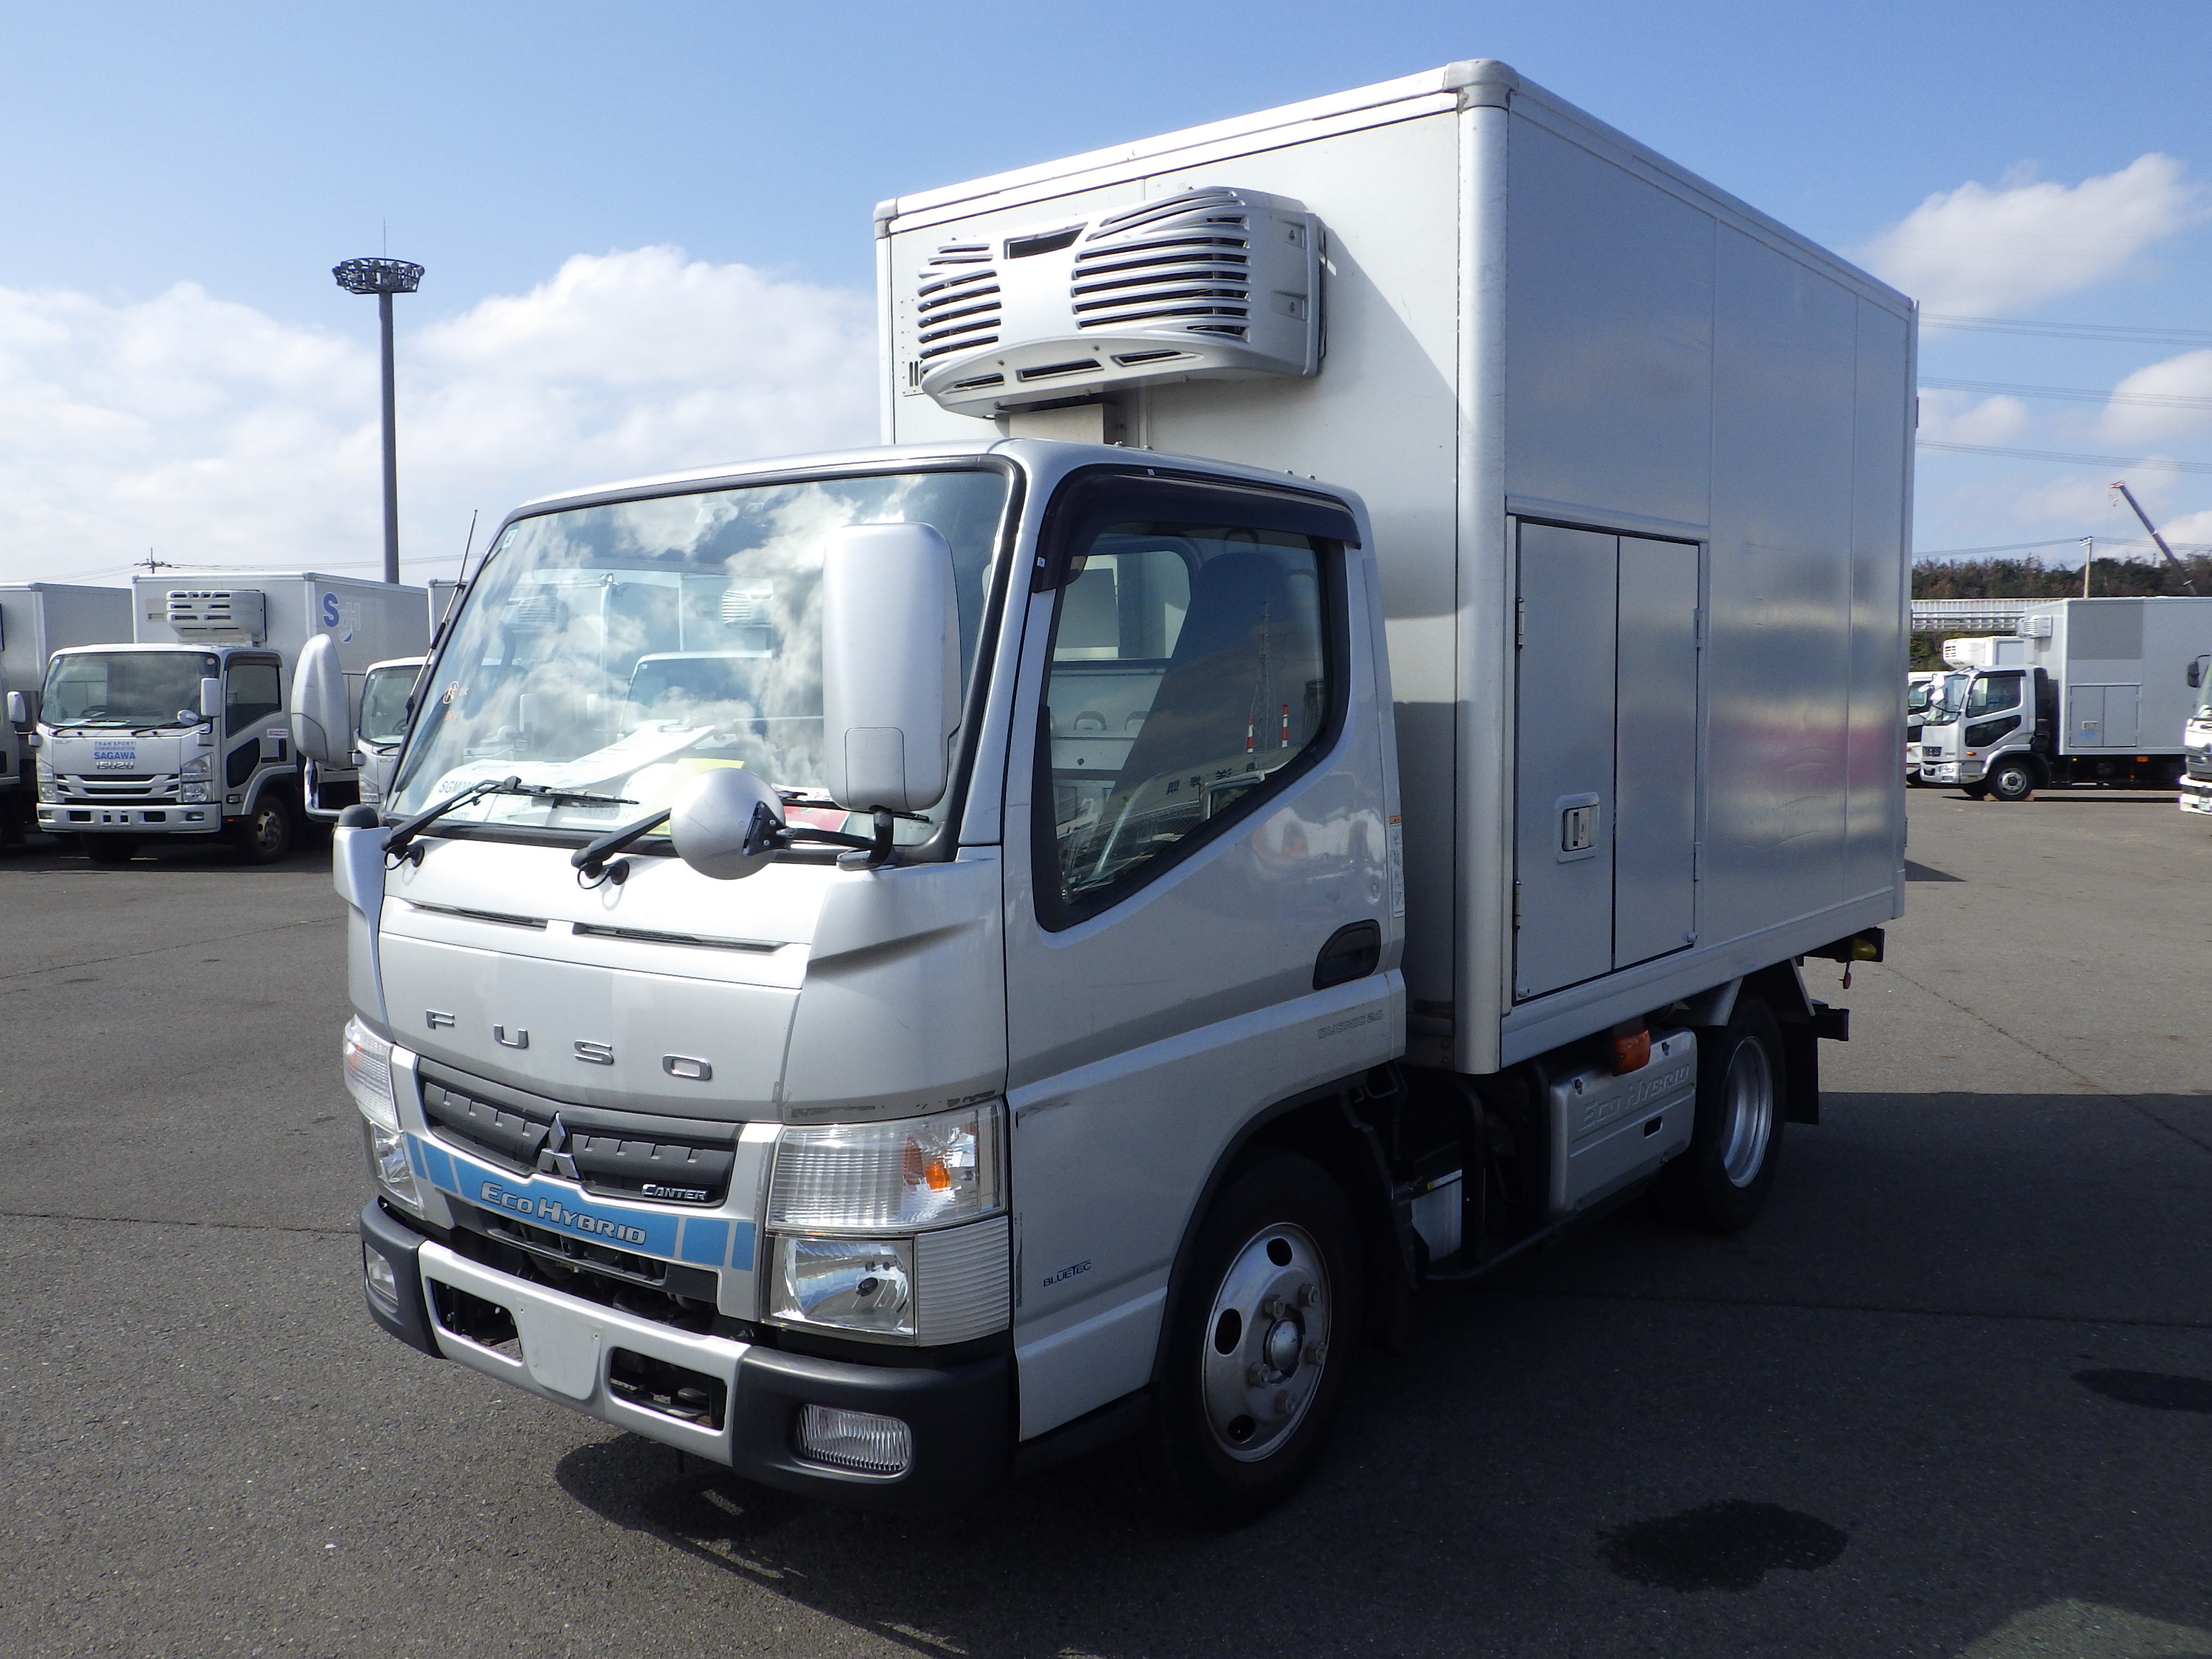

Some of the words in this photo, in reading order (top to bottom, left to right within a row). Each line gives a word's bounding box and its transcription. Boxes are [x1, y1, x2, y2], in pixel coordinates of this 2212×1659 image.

[94, 751, 136, 760] SAGAWA
[96, 761, 134, 770] ISUZU
[426, 1009, 712, 1081] FUSO
[641, 1184, 709, 1201] CANTER
[536, 1197, 647, 1246] HYBRID
[1043, 1260, 1092, 1287] BLUETEC
